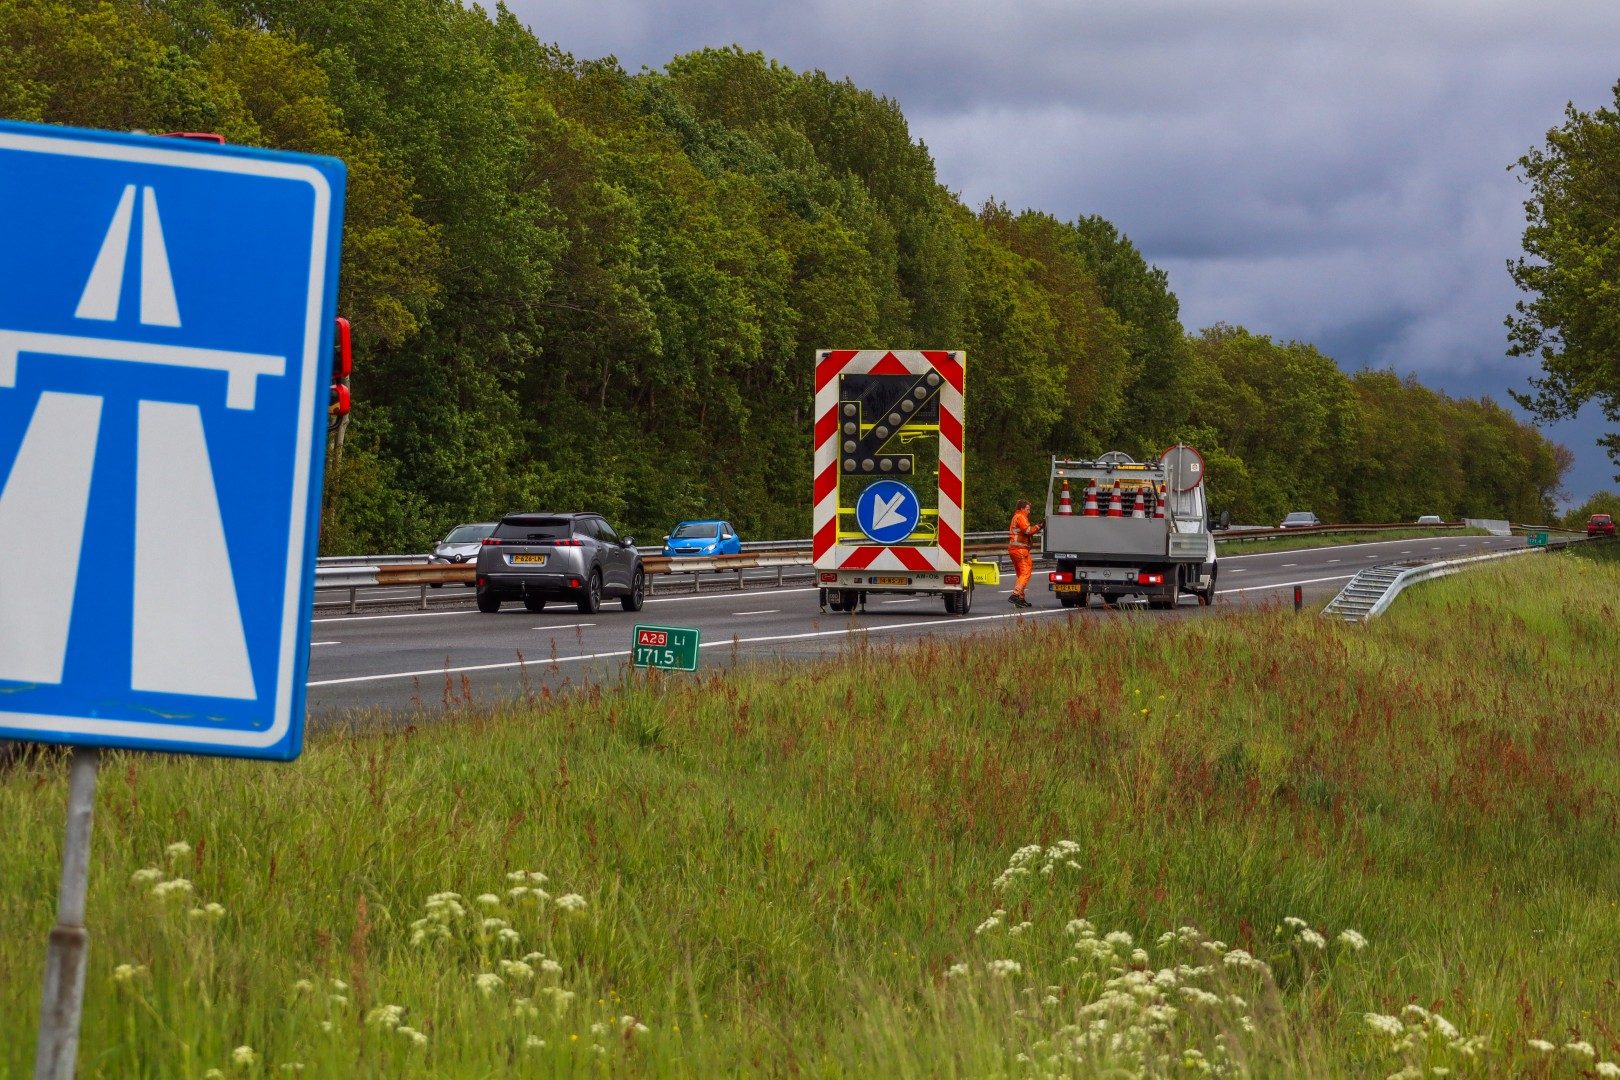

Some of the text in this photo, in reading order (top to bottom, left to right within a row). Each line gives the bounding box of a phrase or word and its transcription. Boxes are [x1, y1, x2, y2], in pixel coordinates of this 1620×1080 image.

[640, 632, 685, 646] A28 Li
[637, 648, 674, 665] 171.5
